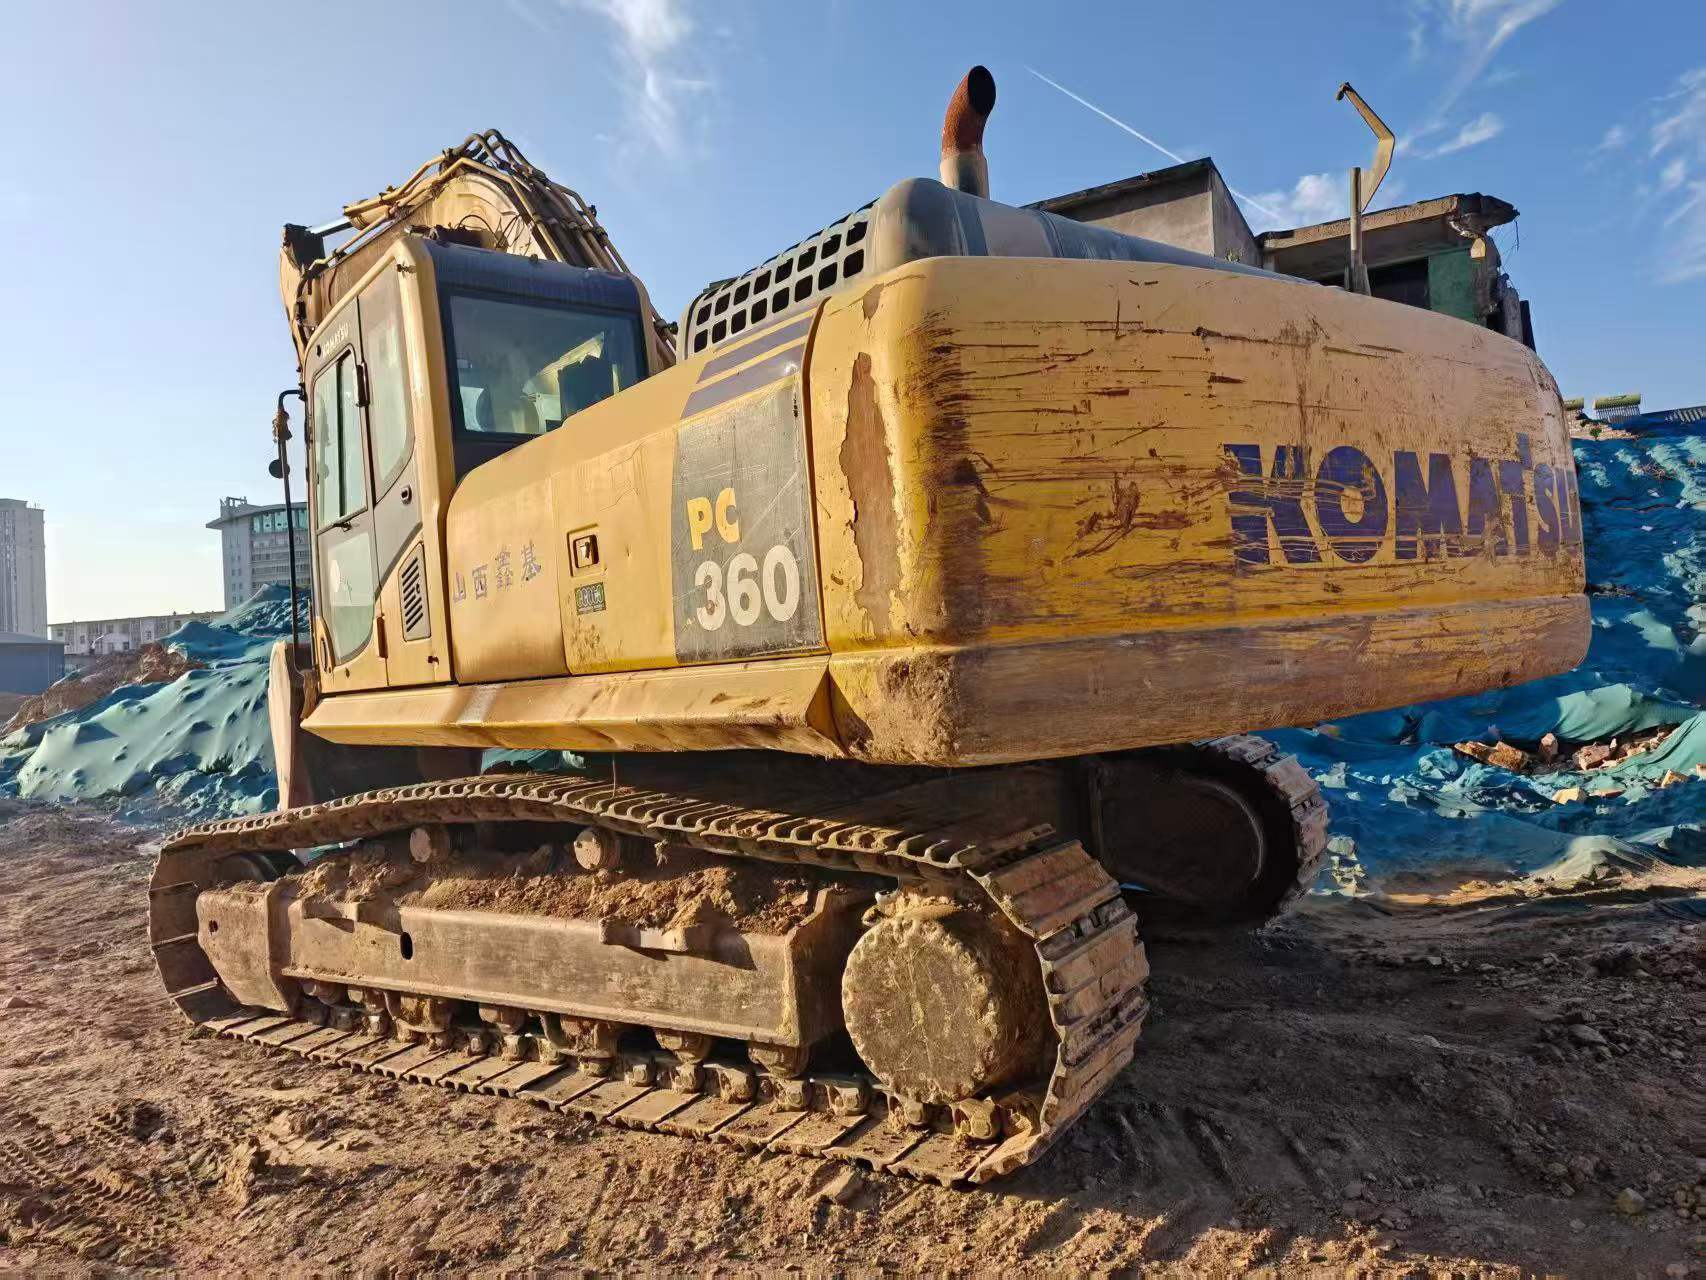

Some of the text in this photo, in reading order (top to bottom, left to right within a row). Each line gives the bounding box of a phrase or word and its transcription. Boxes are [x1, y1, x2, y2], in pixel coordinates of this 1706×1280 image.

[686, 487, 740, 551] PC
[1224, 432, 1582, 564] KOMATSU
[694, 544, 800, 631] 360
